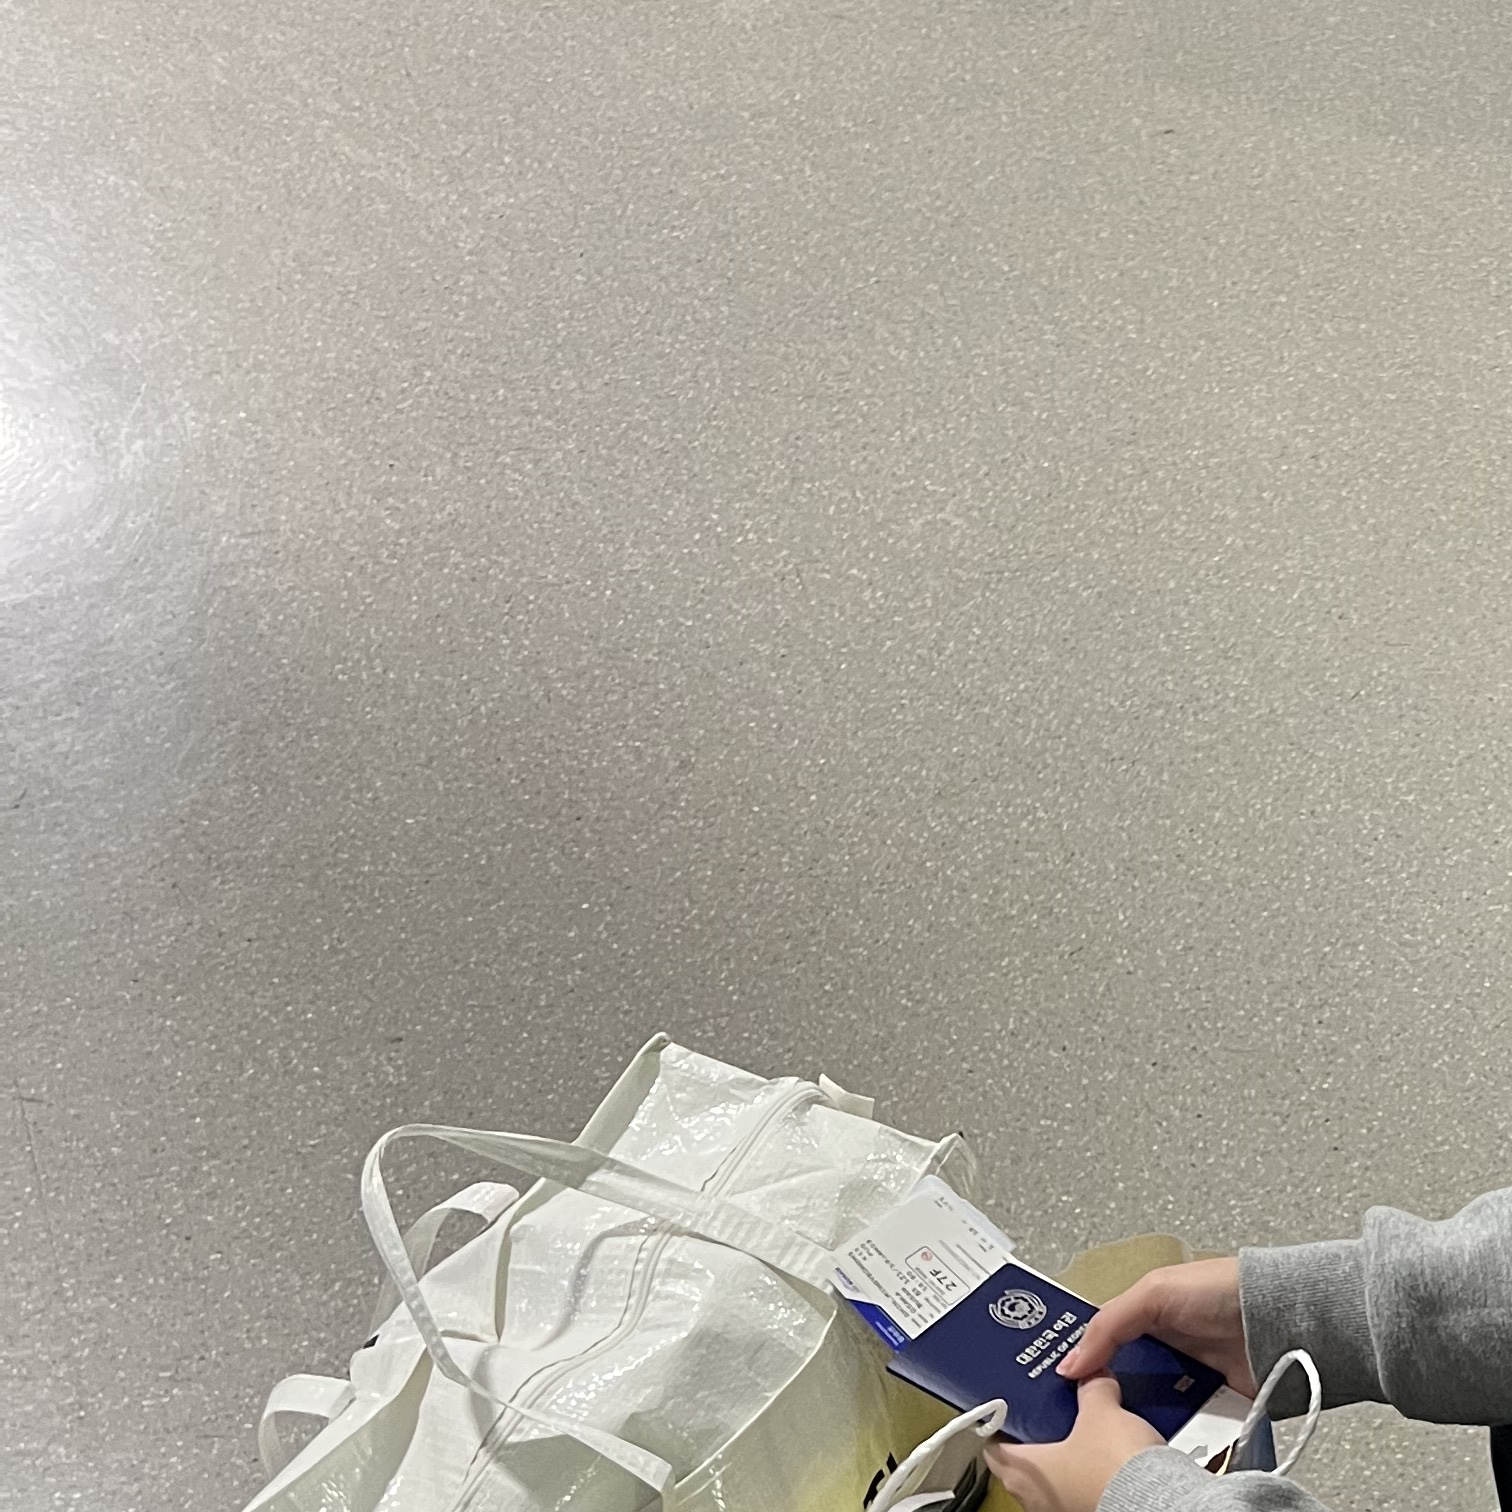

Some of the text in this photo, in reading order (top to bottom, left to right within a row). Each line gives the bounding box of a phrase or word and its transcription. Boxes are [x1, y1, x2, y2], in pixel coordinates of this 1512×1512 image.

[929, 1265, 956, 1292] 27F
[1014, 1311, 1077, 1366] 대한민국 여권
